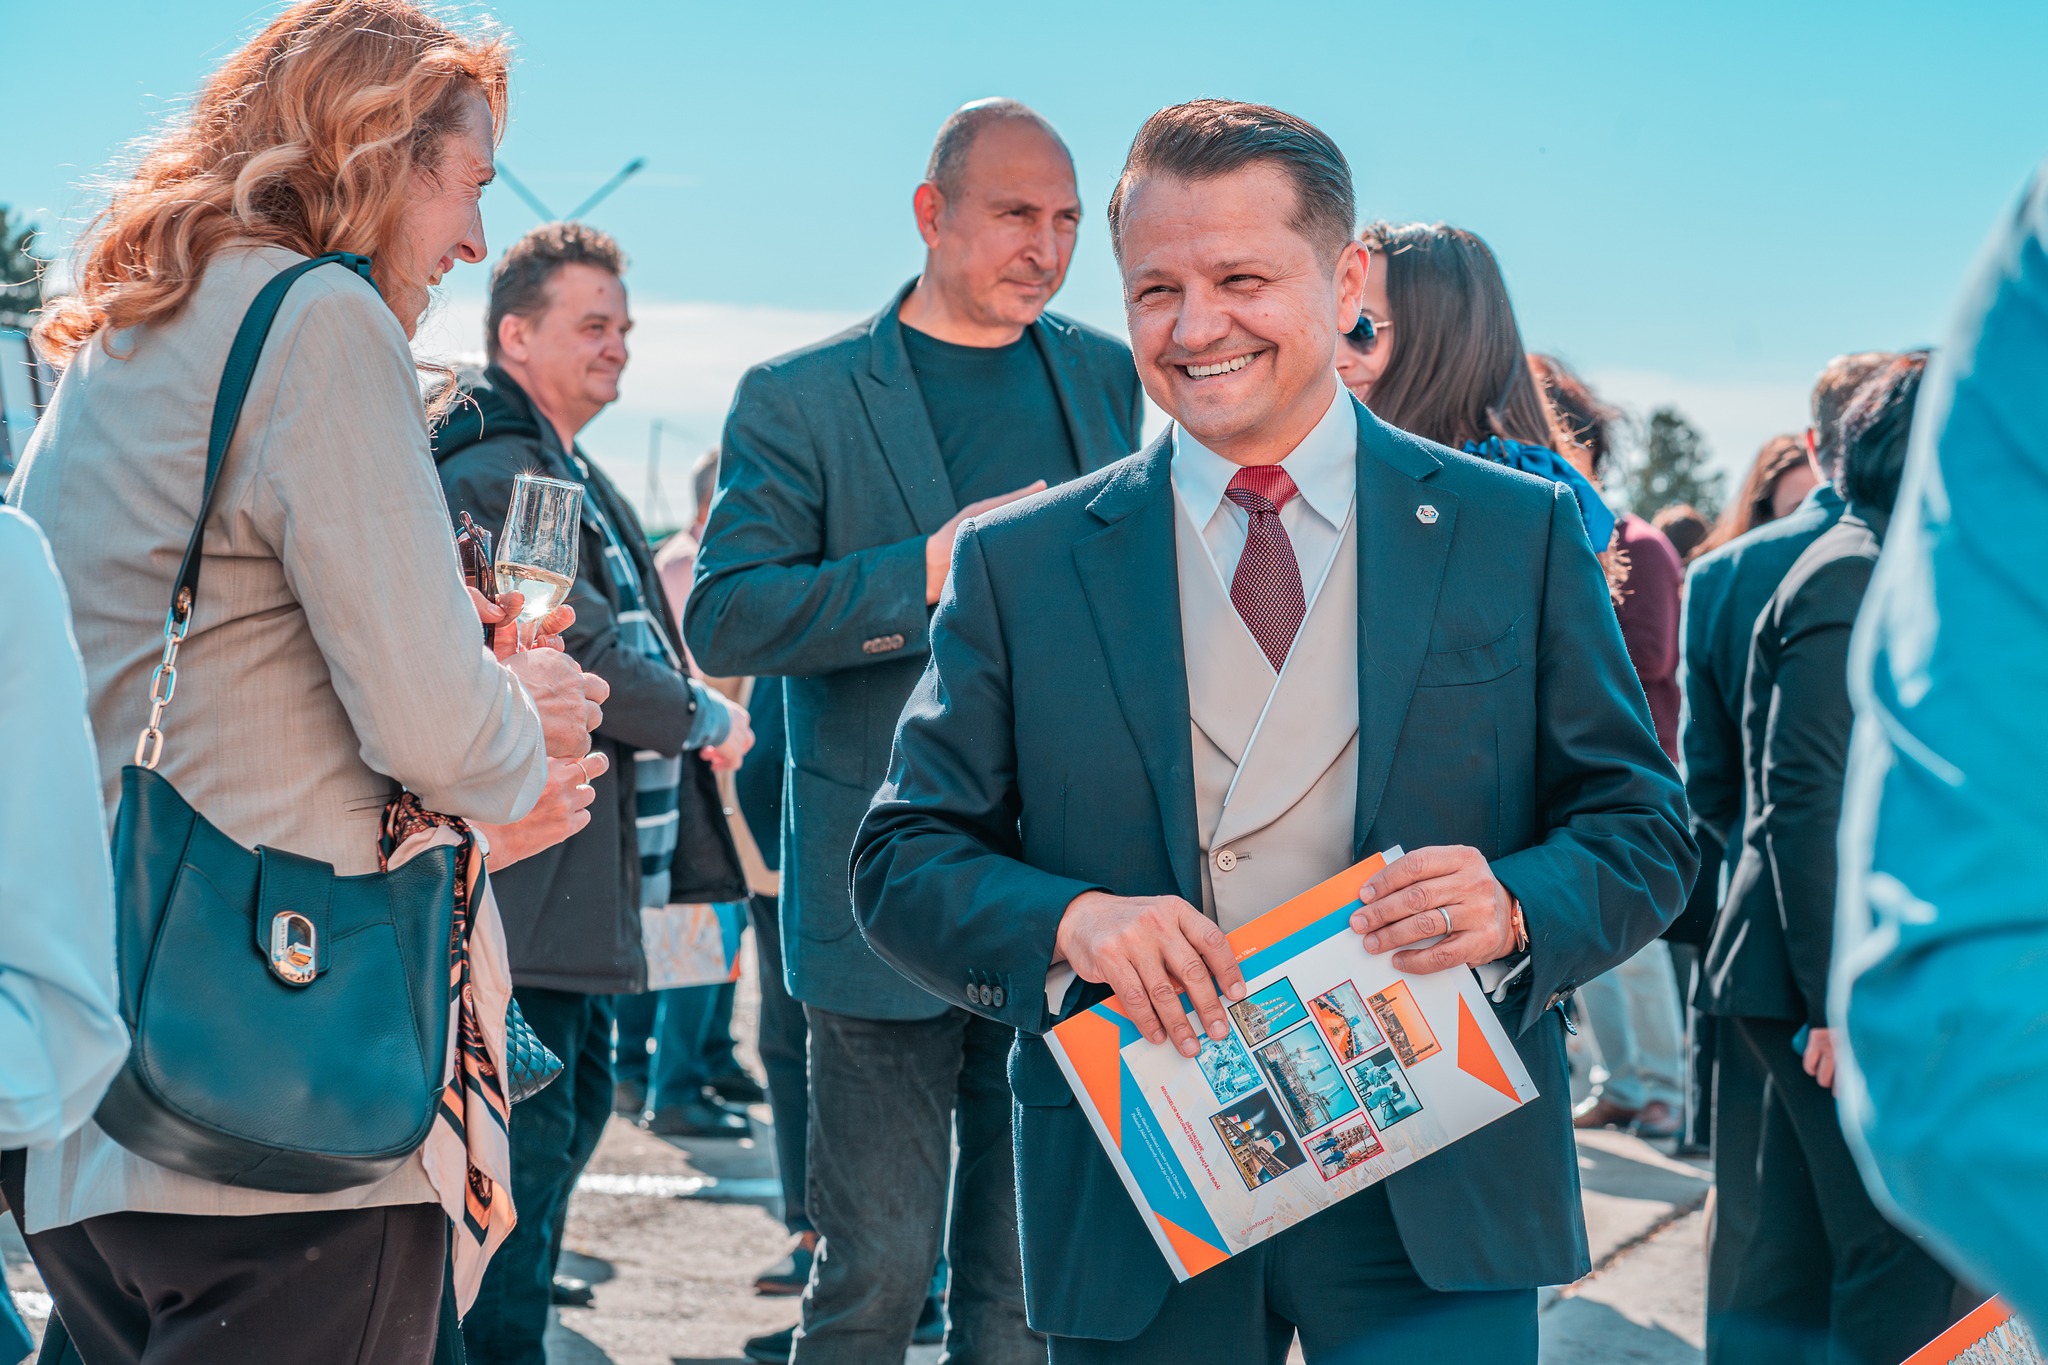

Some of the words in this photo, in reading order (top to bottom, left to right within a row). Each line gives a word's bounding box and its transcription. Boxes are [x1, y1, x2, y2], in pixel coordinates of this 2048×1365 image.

[1161, 1086, 1177, 1112] RESURSELOR
[1175, 1112, 1190, 1134] NATURALE
[1188, 1135, 1199, 1151] PENTRU
[1191, 1132, 1204, 1151] VALOARE
[1246, 1216, 1274, 1231] romfilatelia
